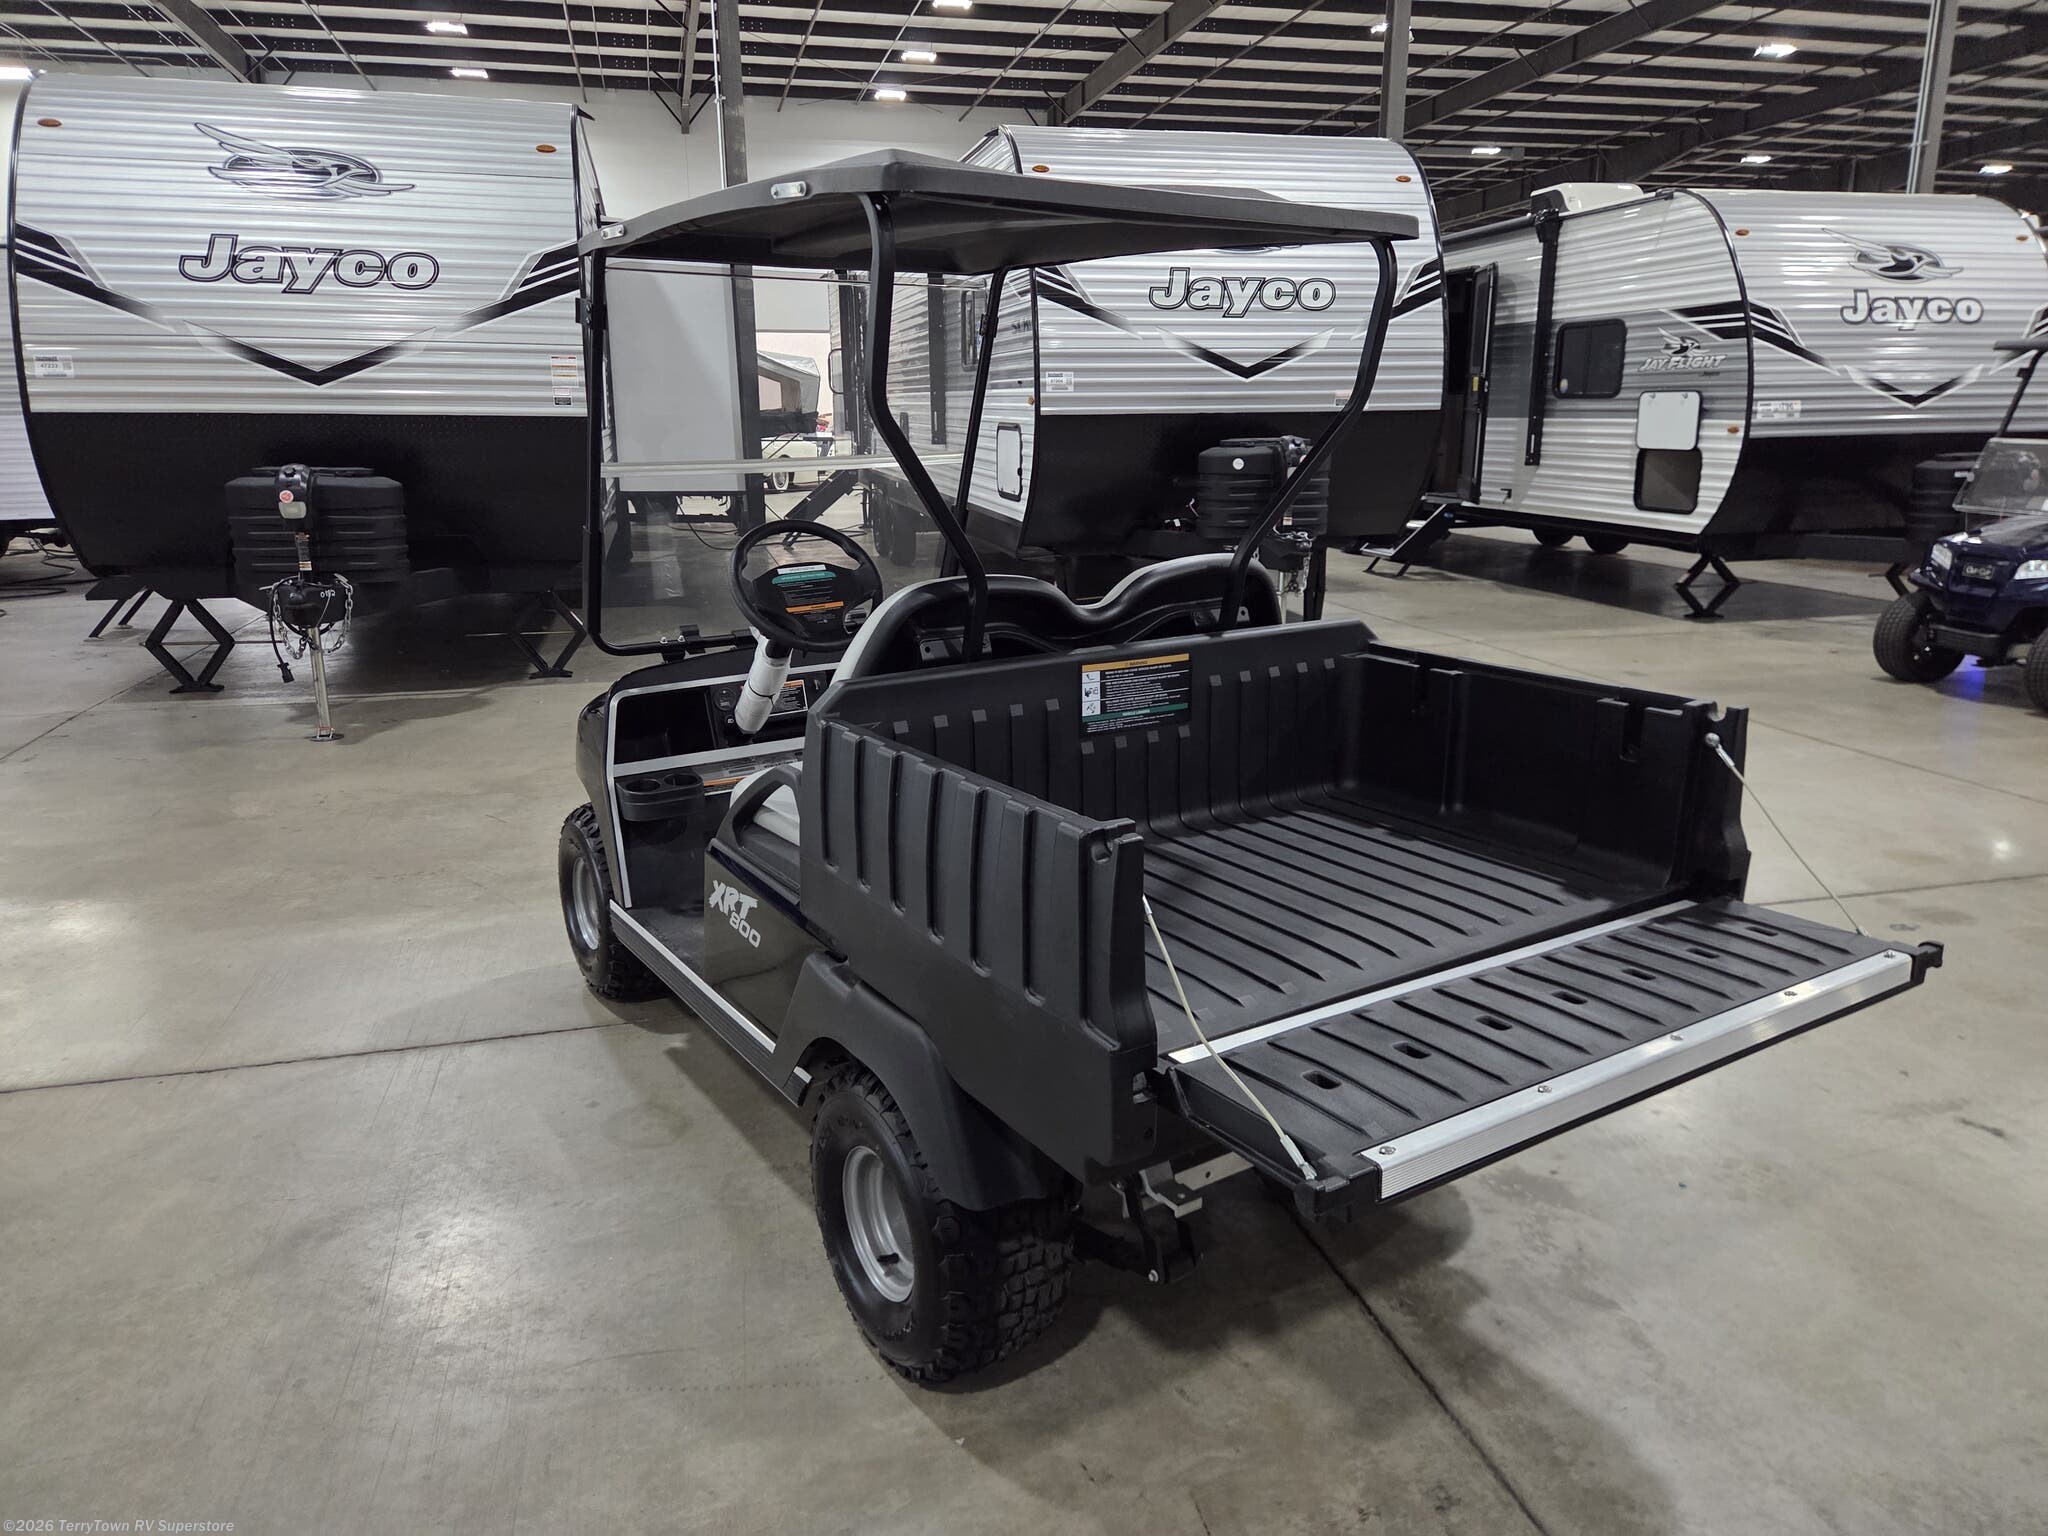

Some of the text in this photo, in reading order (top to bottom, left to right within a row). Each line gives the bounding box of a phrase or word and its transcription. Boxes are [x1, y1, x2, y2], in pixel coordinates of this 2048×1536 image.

[179, 233, 439, 294] Jayco
[1149, 267, 1336, 318] Jayco
[1840, 288, 1984, 331] Jayco
[1638, 354, 1728, 372] JAY FLIGHT
[708, 880, 759, 920] XRT
[729, 911, 761, 948] 800
